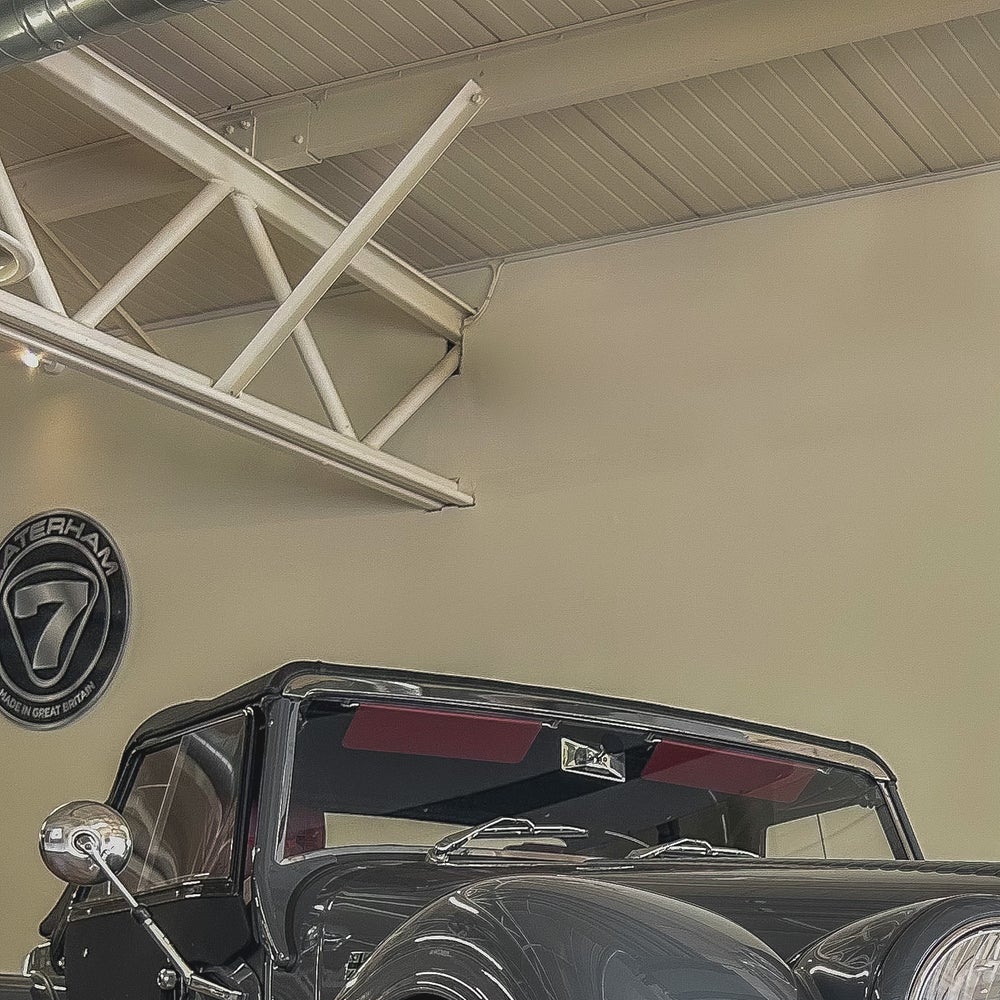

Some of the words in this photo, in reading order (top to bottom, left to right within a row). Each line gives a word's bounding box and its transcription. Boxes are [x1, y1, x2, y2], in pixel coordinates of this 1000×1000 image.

[0, 517, 119, 577] ATERHAM
[14, 580, 89, 669] 7
[0, 688, 21, 712] MADE
[21, 705, 32, 716] IN
[32, 704, 62, 718] GREAT
[62, 680, 96, 712] BRITAIN
